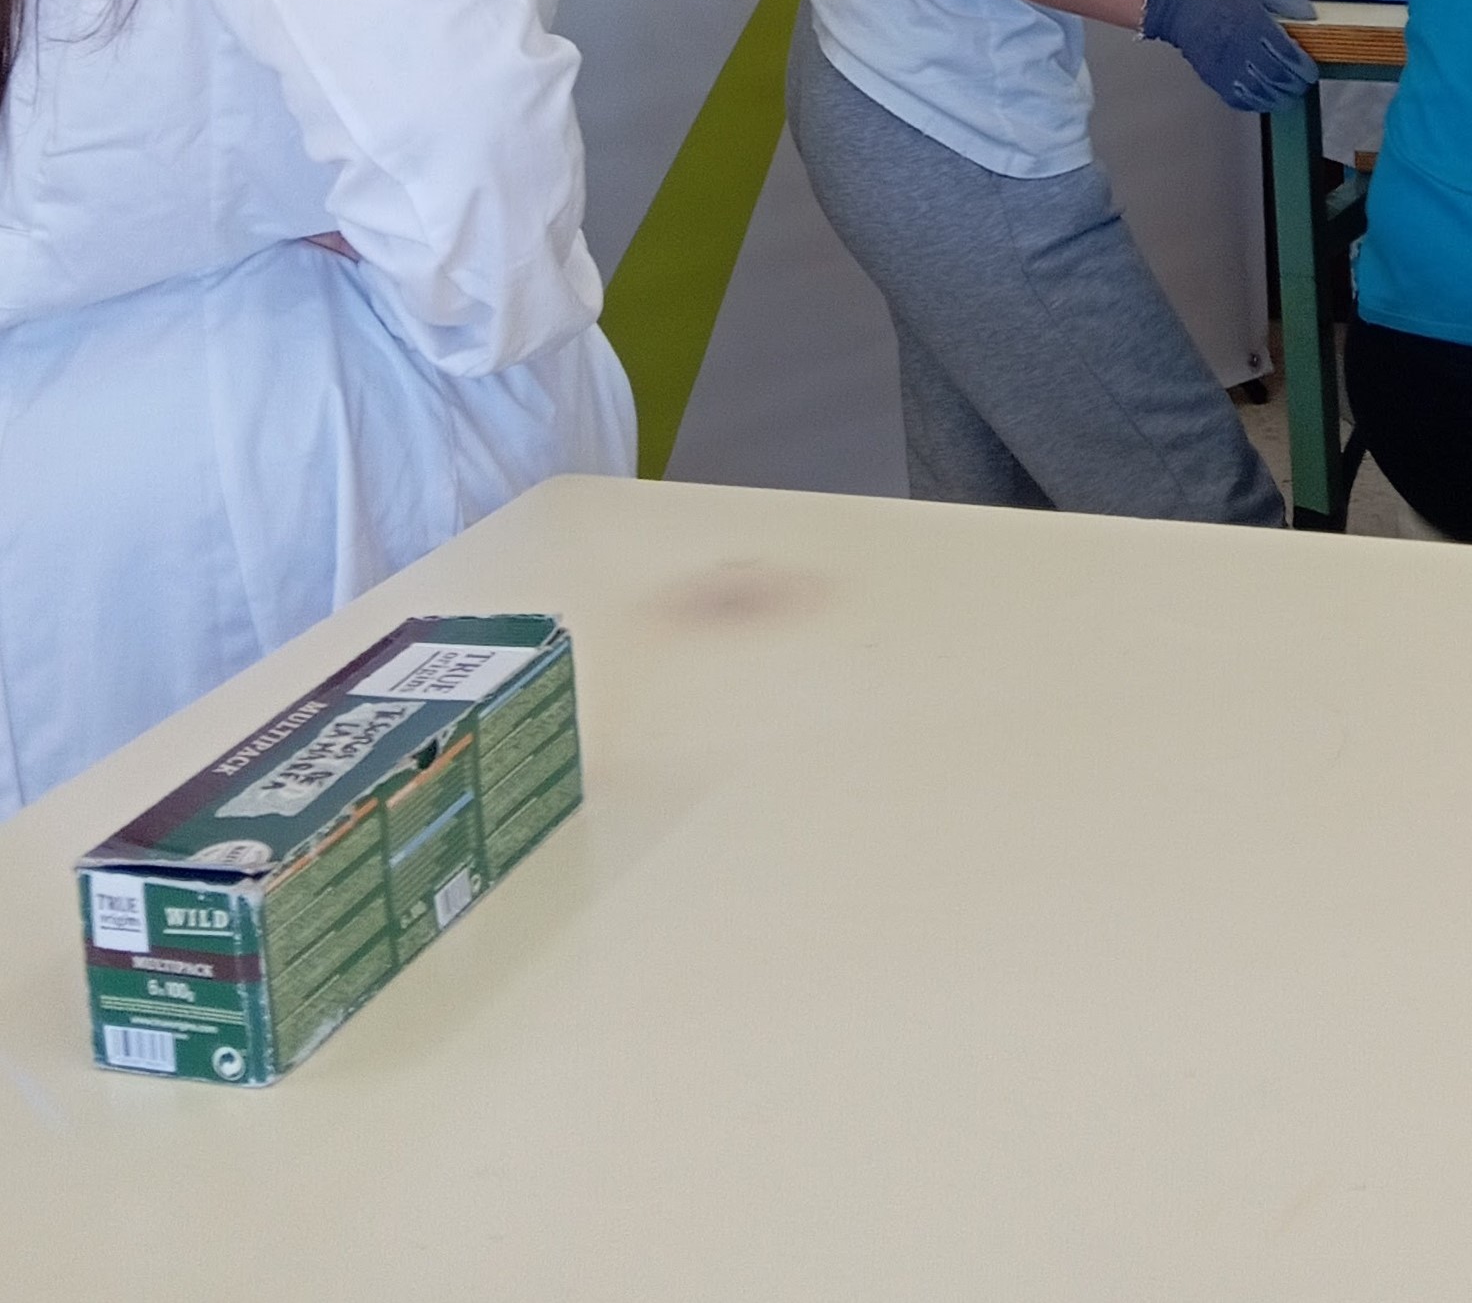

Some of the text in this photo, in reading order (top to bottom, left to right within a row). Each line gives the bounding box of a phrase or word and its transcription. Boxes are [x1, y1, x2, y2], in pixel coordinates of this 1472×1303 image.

[423, 651, 496, 694] TRUE
[211, 700, 328, 777] MULTIPACK
[164, 906, 230, 929] WILD
